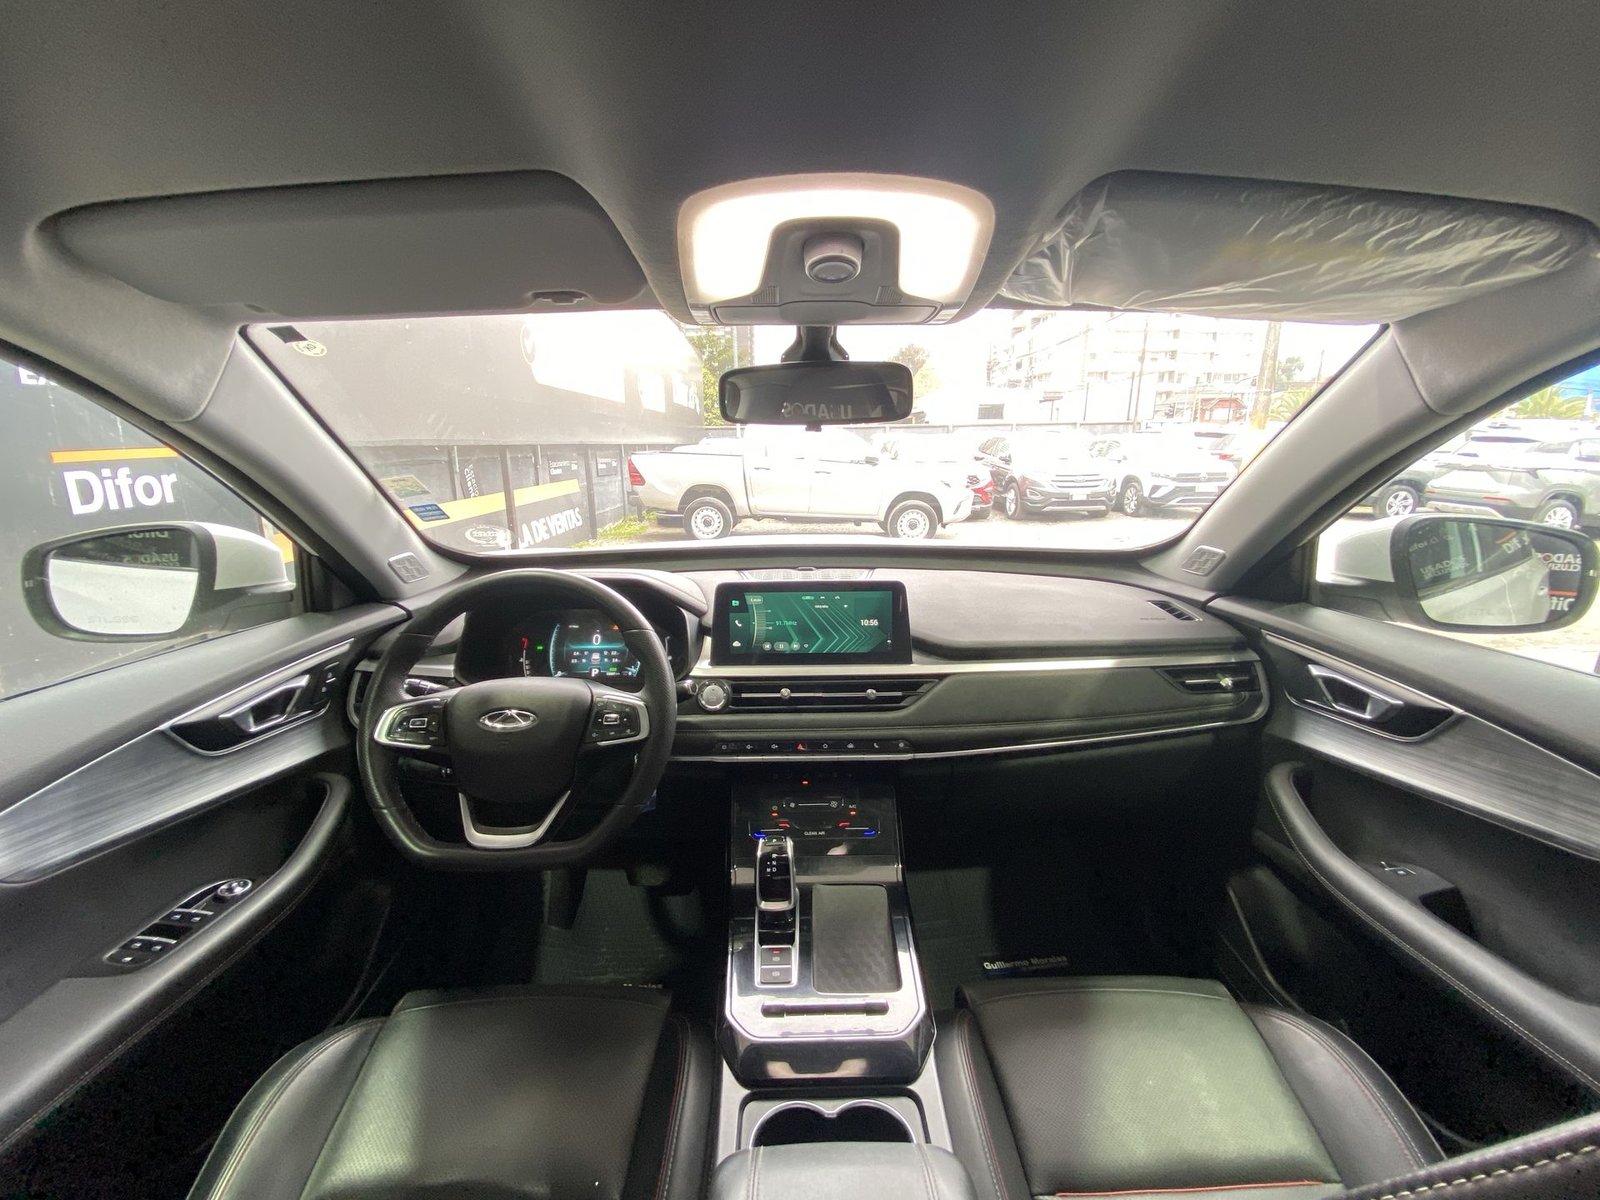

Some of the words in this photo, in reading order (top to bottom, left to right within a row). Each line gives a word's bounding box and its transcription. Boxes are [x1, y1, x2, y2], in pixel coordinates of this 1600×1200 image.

[63, 466, 178, 515] Difor
[530, 517, 550, 543] DE
[546, 507, 583, 536] VENTAS
[592, 634, 601, 645] 0
[591, 668, 599, 678] P
